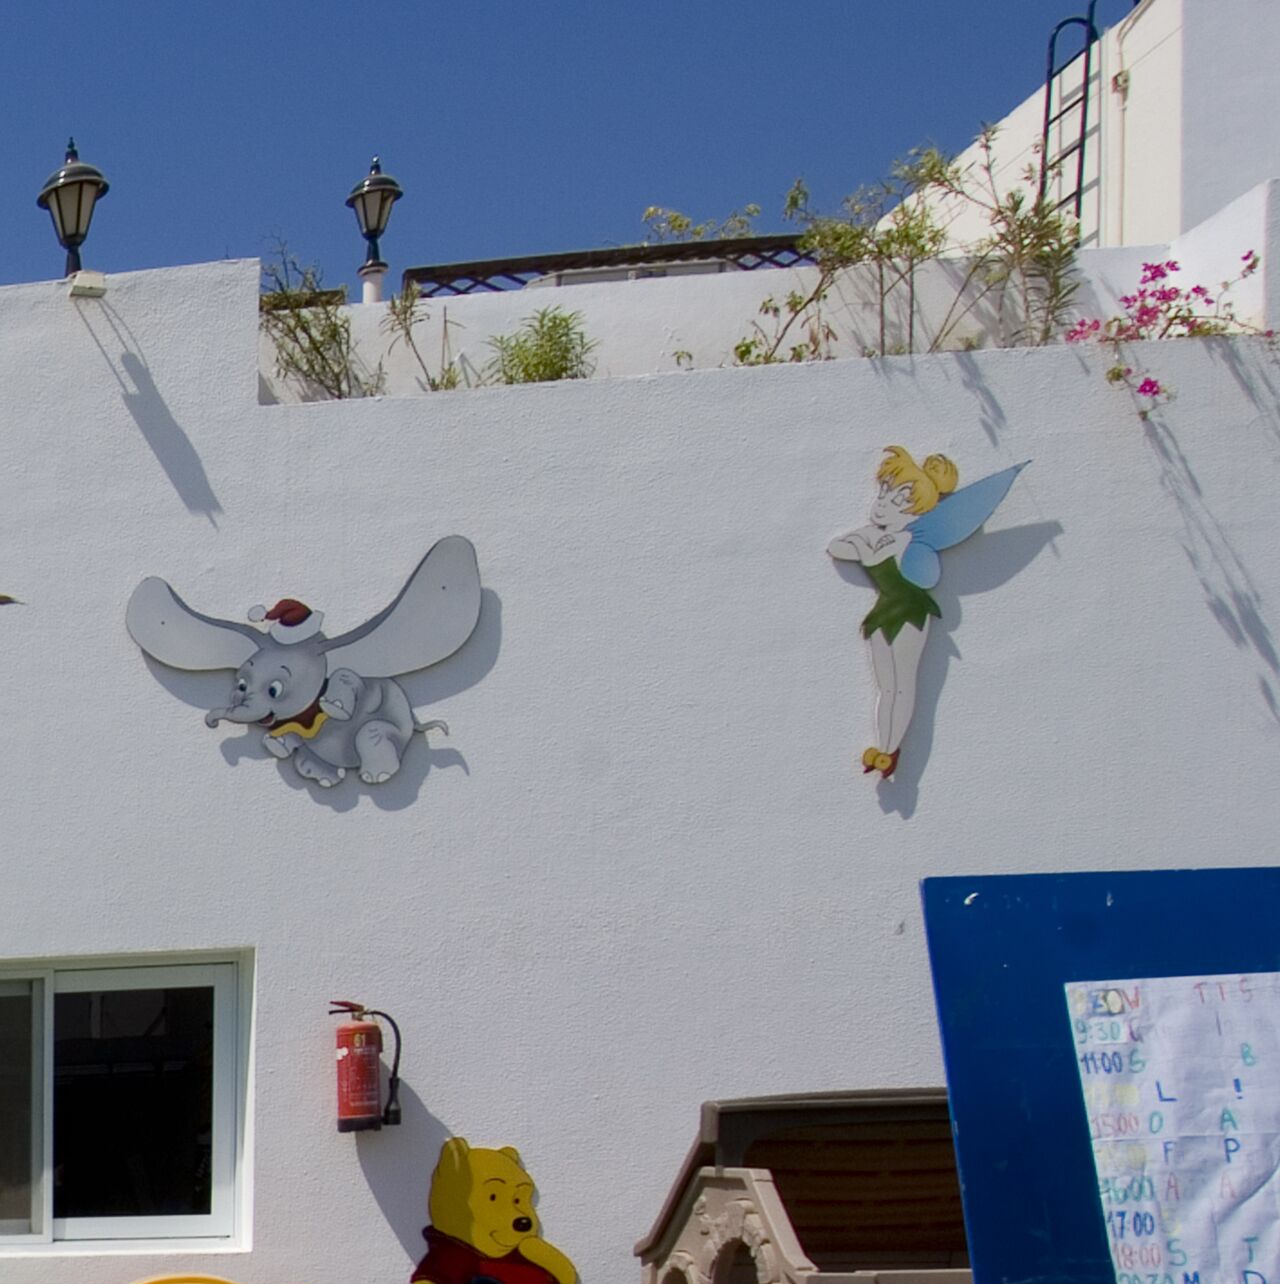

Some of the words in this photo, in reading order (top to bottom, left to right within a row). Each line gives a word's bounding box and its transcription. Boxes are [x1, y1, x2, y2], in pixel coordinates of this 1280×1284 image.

[1075, 1018, 1121, 1044] 9:30
[1080, 1051, 1123, 1075] 11:00
[1155, 1080, 1179, 1103] L
[1220, 1107, 1239, 1132] A
